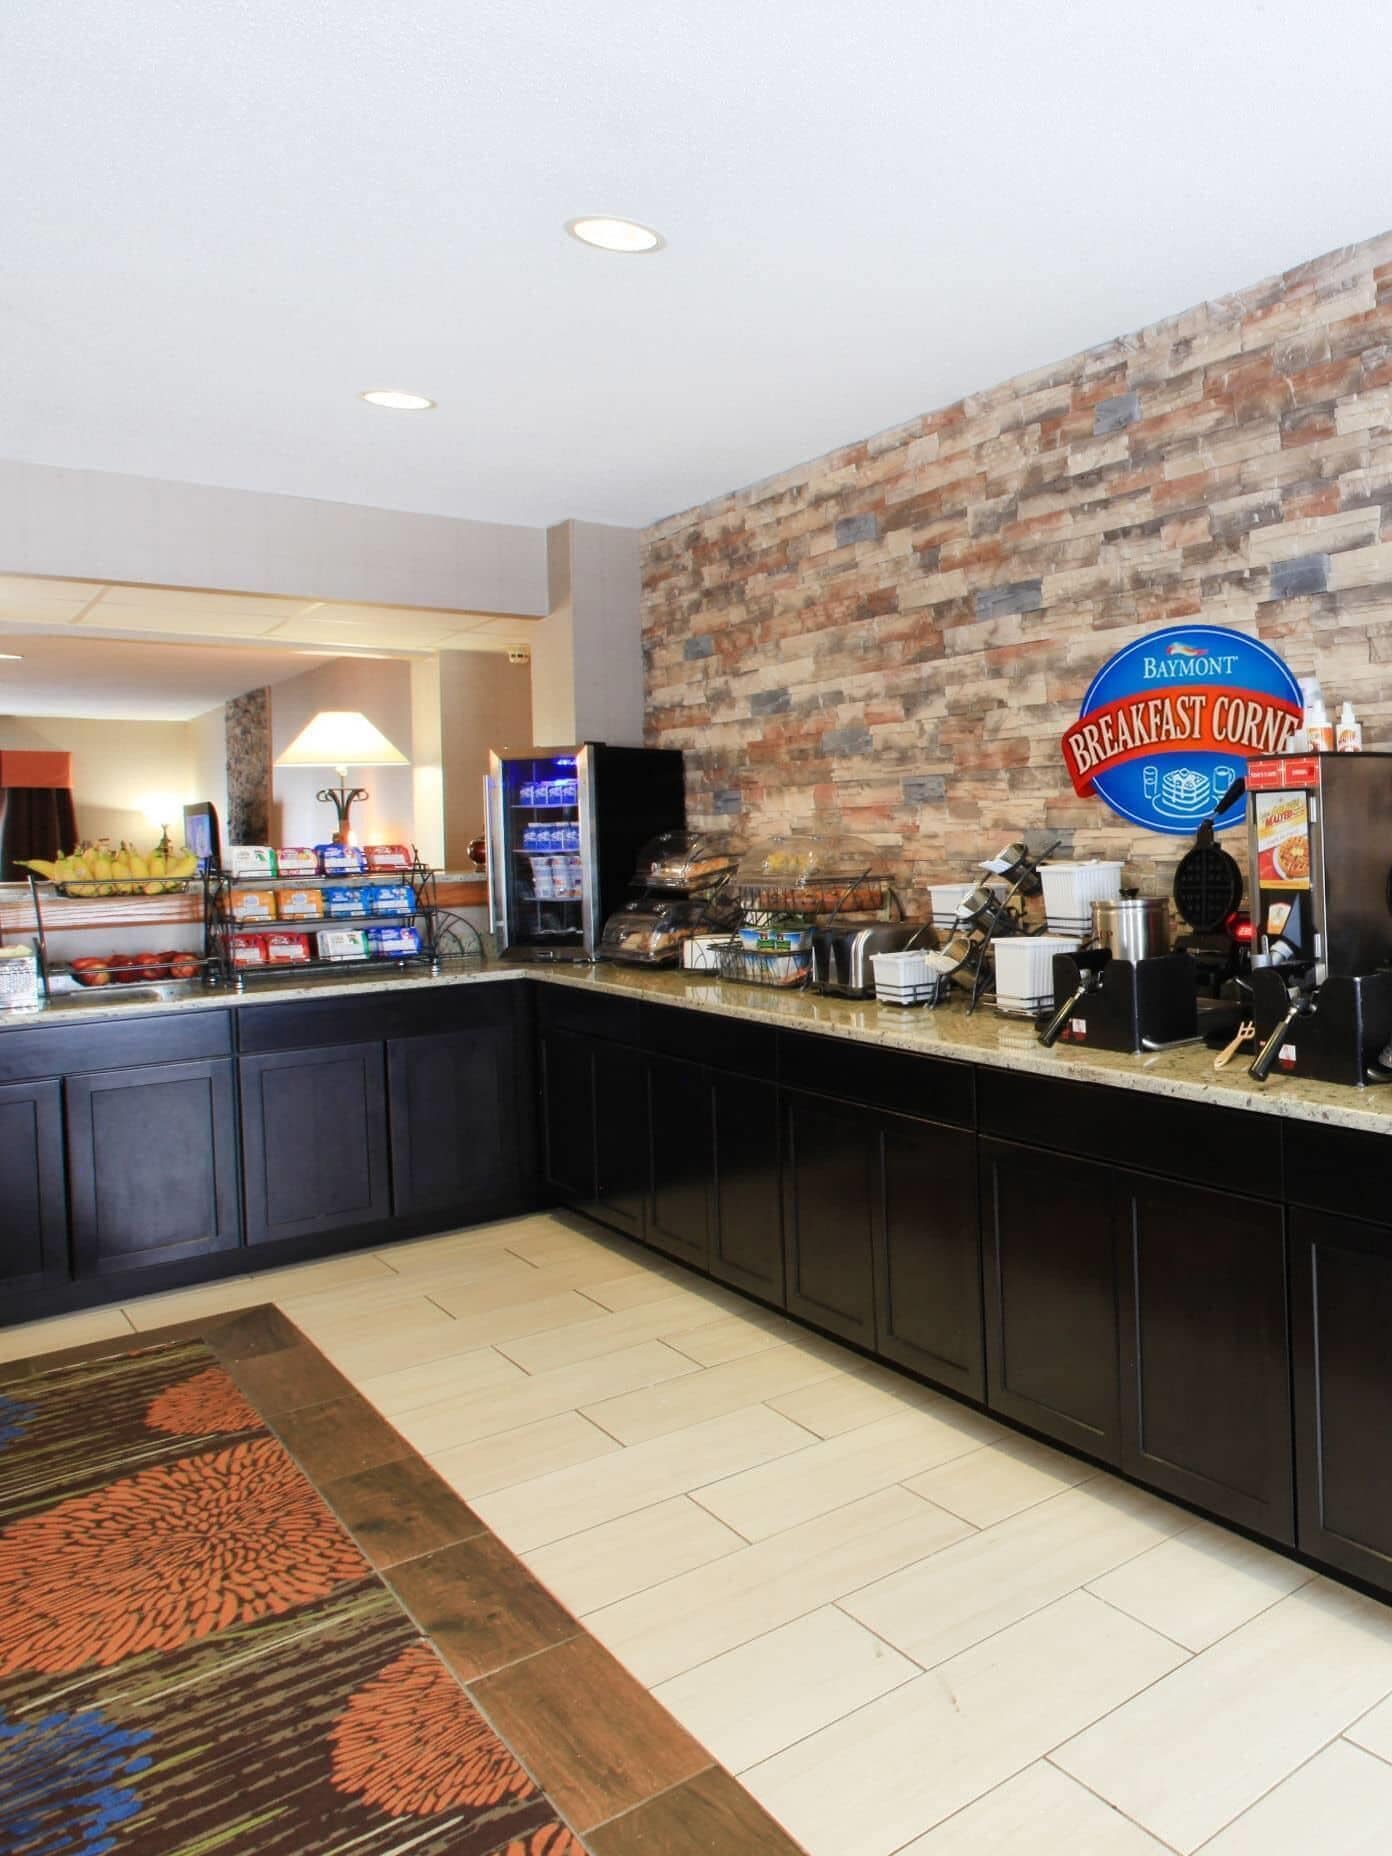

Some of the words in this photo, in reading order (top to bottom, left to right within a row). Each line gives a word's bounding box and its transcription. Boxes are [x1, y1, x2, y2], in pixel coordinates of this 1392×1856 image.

[1143, 656, 1235, 680] BAYMONT
[1068, 696, 1207, 775] BREAKFAST
[1212, 697, 1300, 755] CORNE
